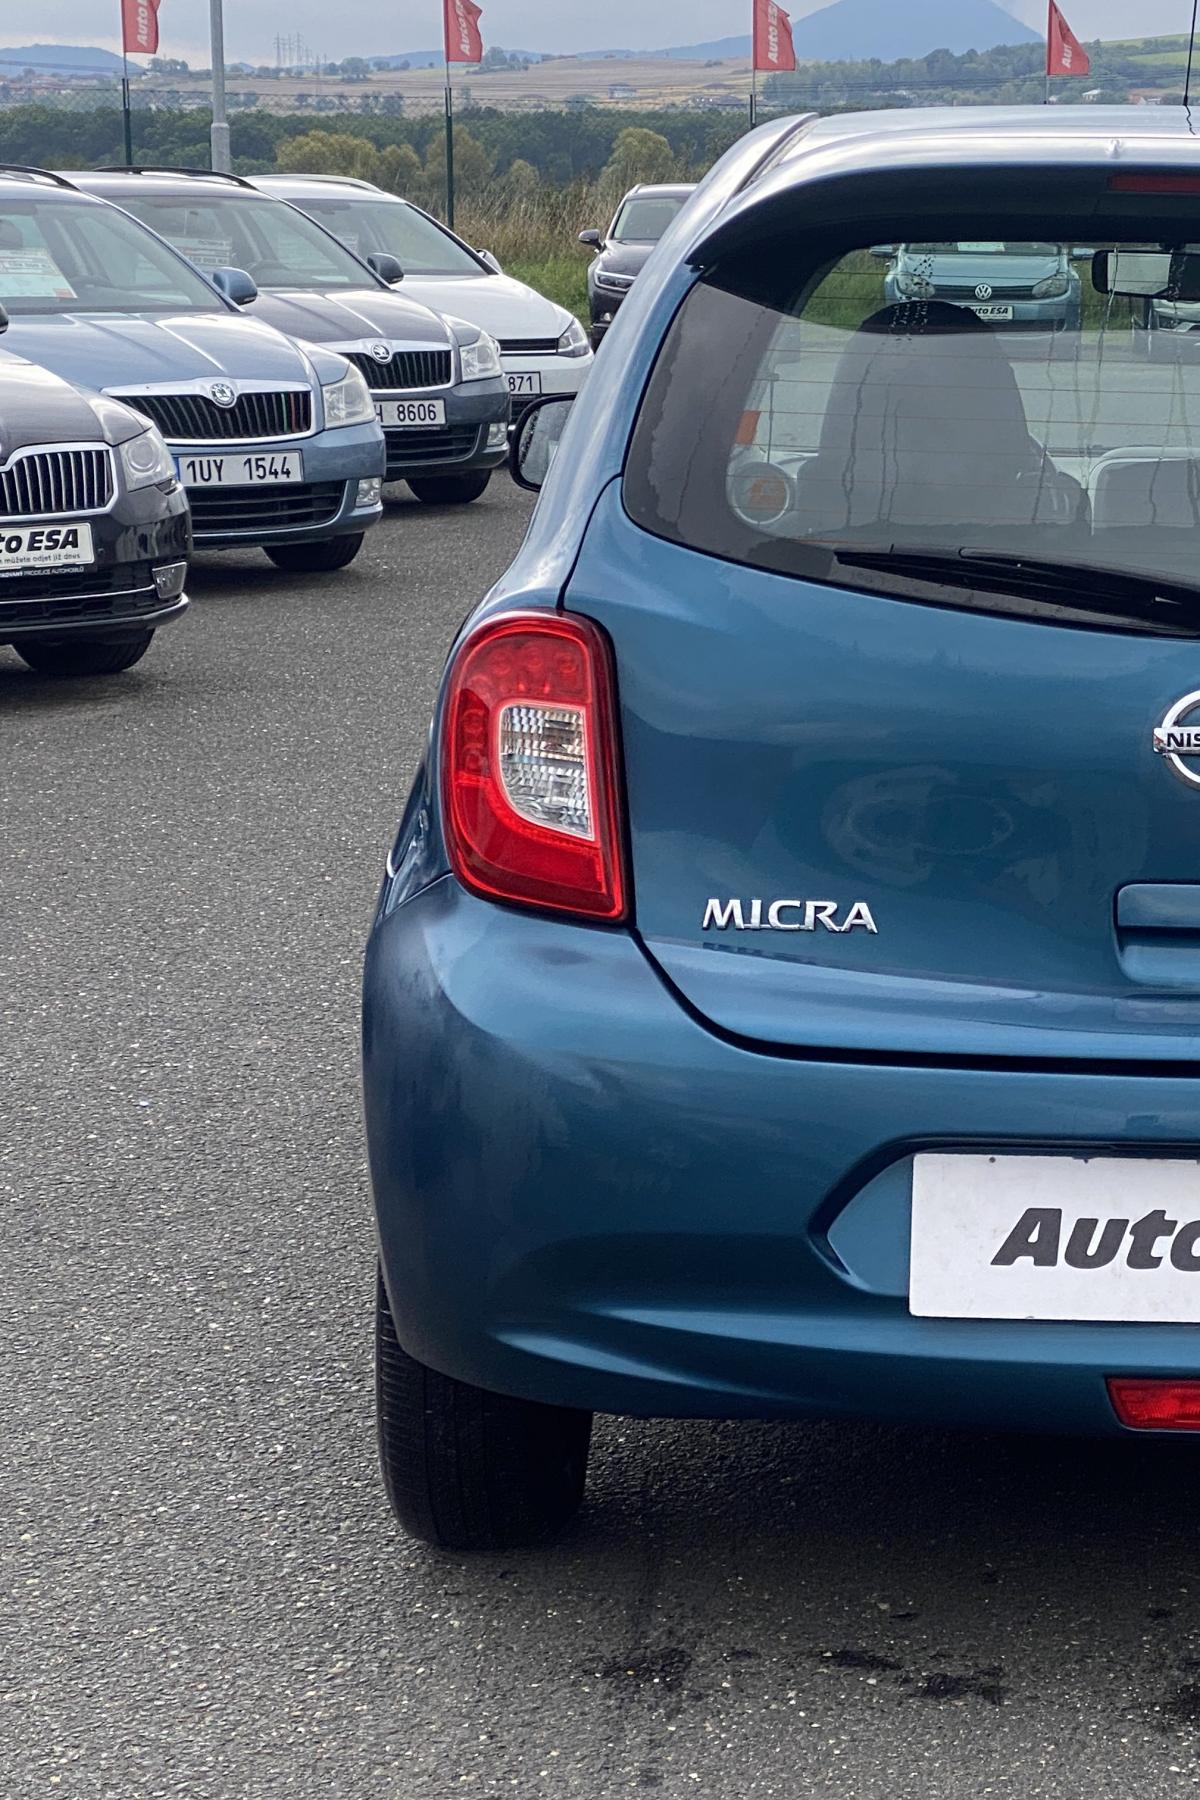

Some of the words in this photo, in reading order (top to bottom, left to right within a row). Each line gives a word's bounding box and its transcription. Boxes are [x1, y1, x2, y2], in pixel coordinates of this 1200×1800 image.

[136, 6, 148, 47] Auto
[767, 25, 779, 64] Auto
[990, 307, 1008, 315] ESA
[396, 403, 437, 422] 8606
[187, 459, 224, 483] 1UY
[243, 456, 291, 480] 1544
[27, 529, 79, 552] ESA
[702, 898, 878, 934] MICRA
